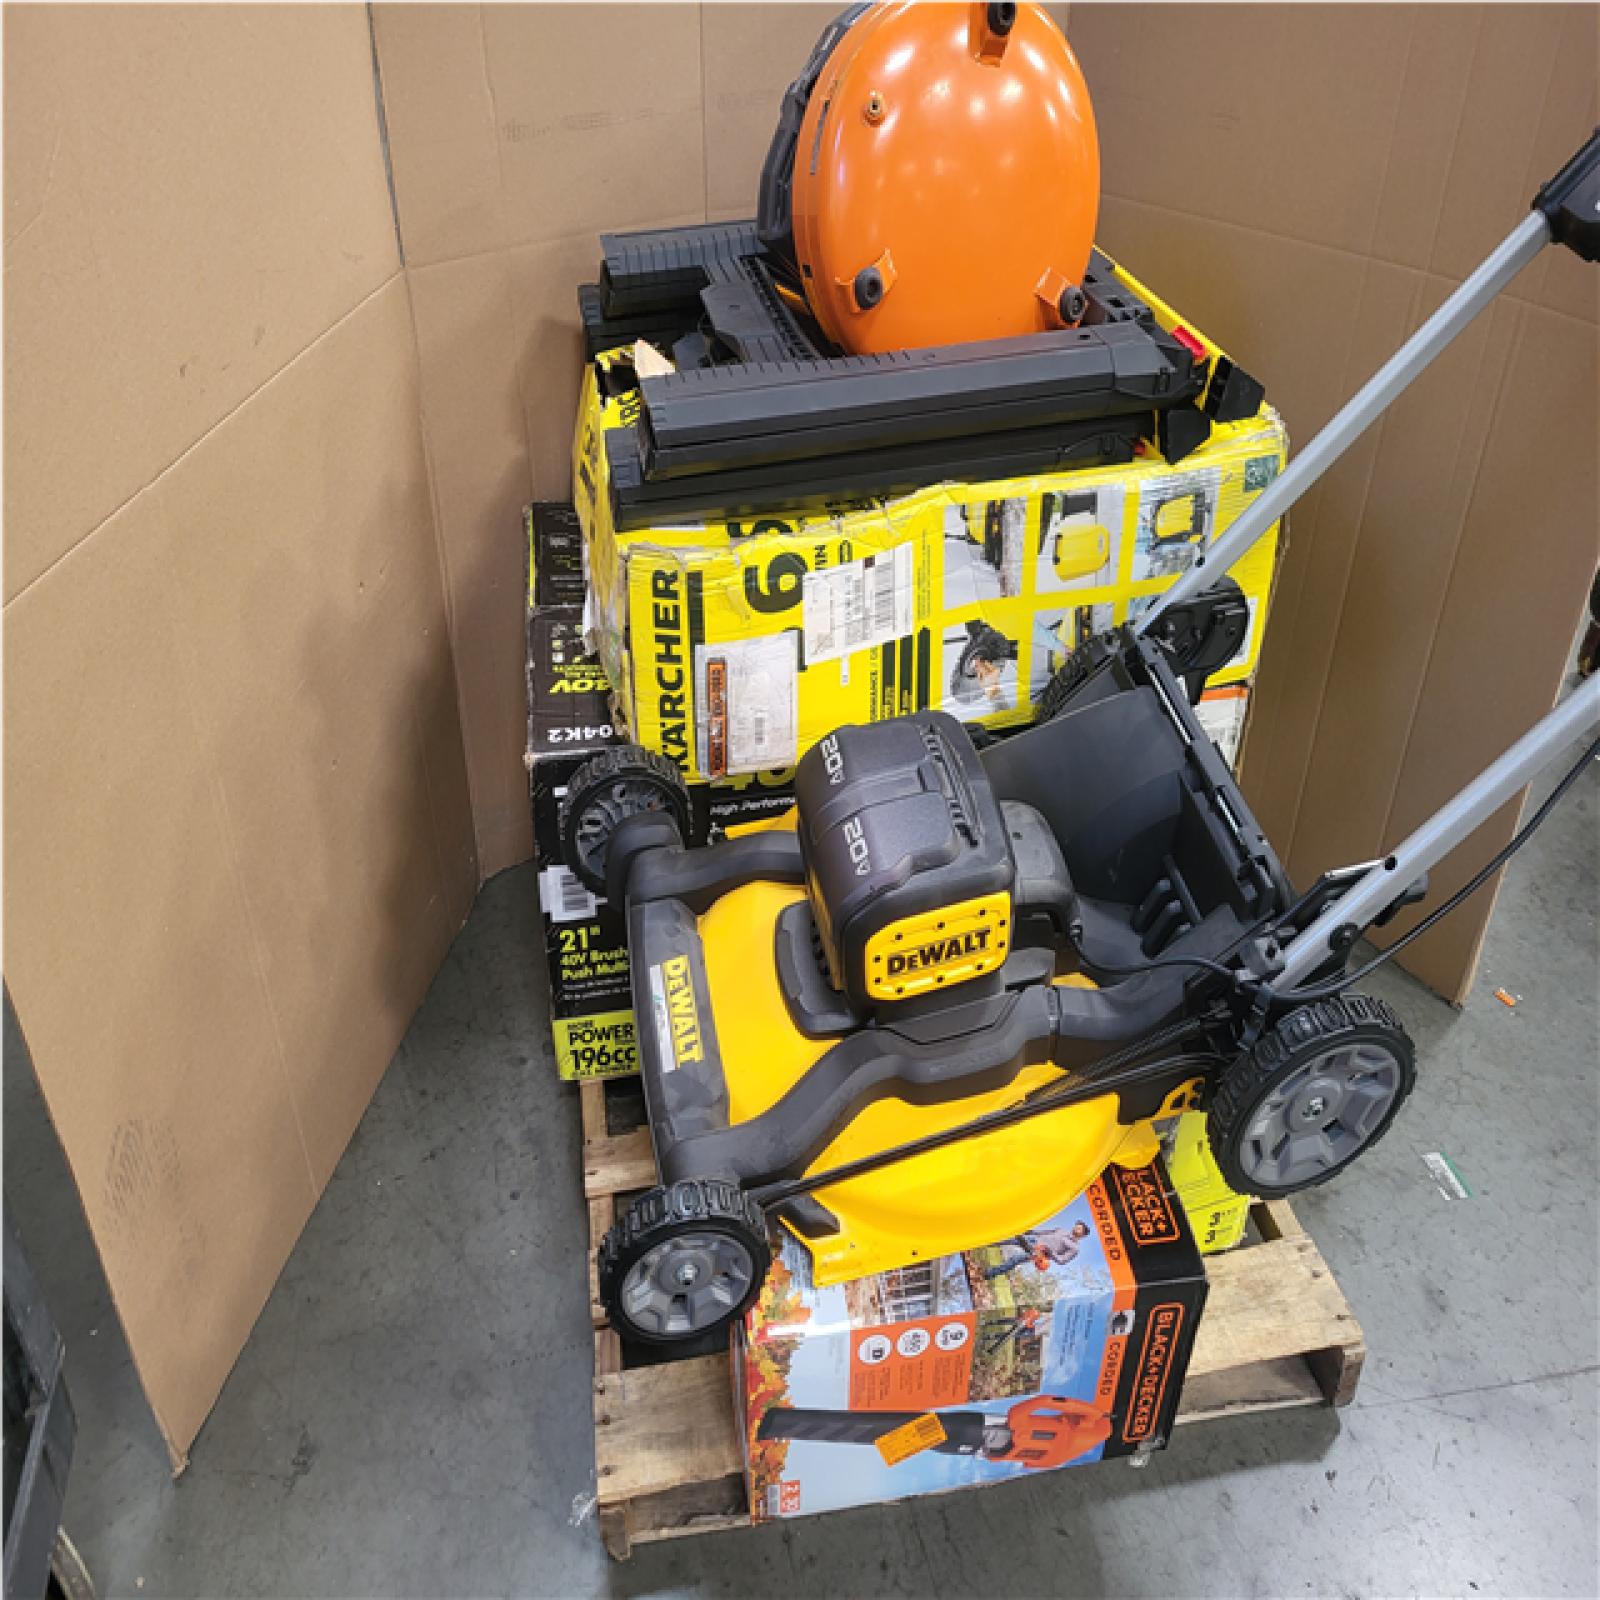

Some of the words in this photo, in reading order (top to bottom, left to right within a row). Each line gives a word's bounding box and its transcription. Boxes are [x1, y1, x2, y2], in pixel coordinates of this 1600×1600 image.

[819, 734, 845, 785] 20V
[842, 816, 871, 876] 20V
[569, 1023, 634, 1046] POWER
